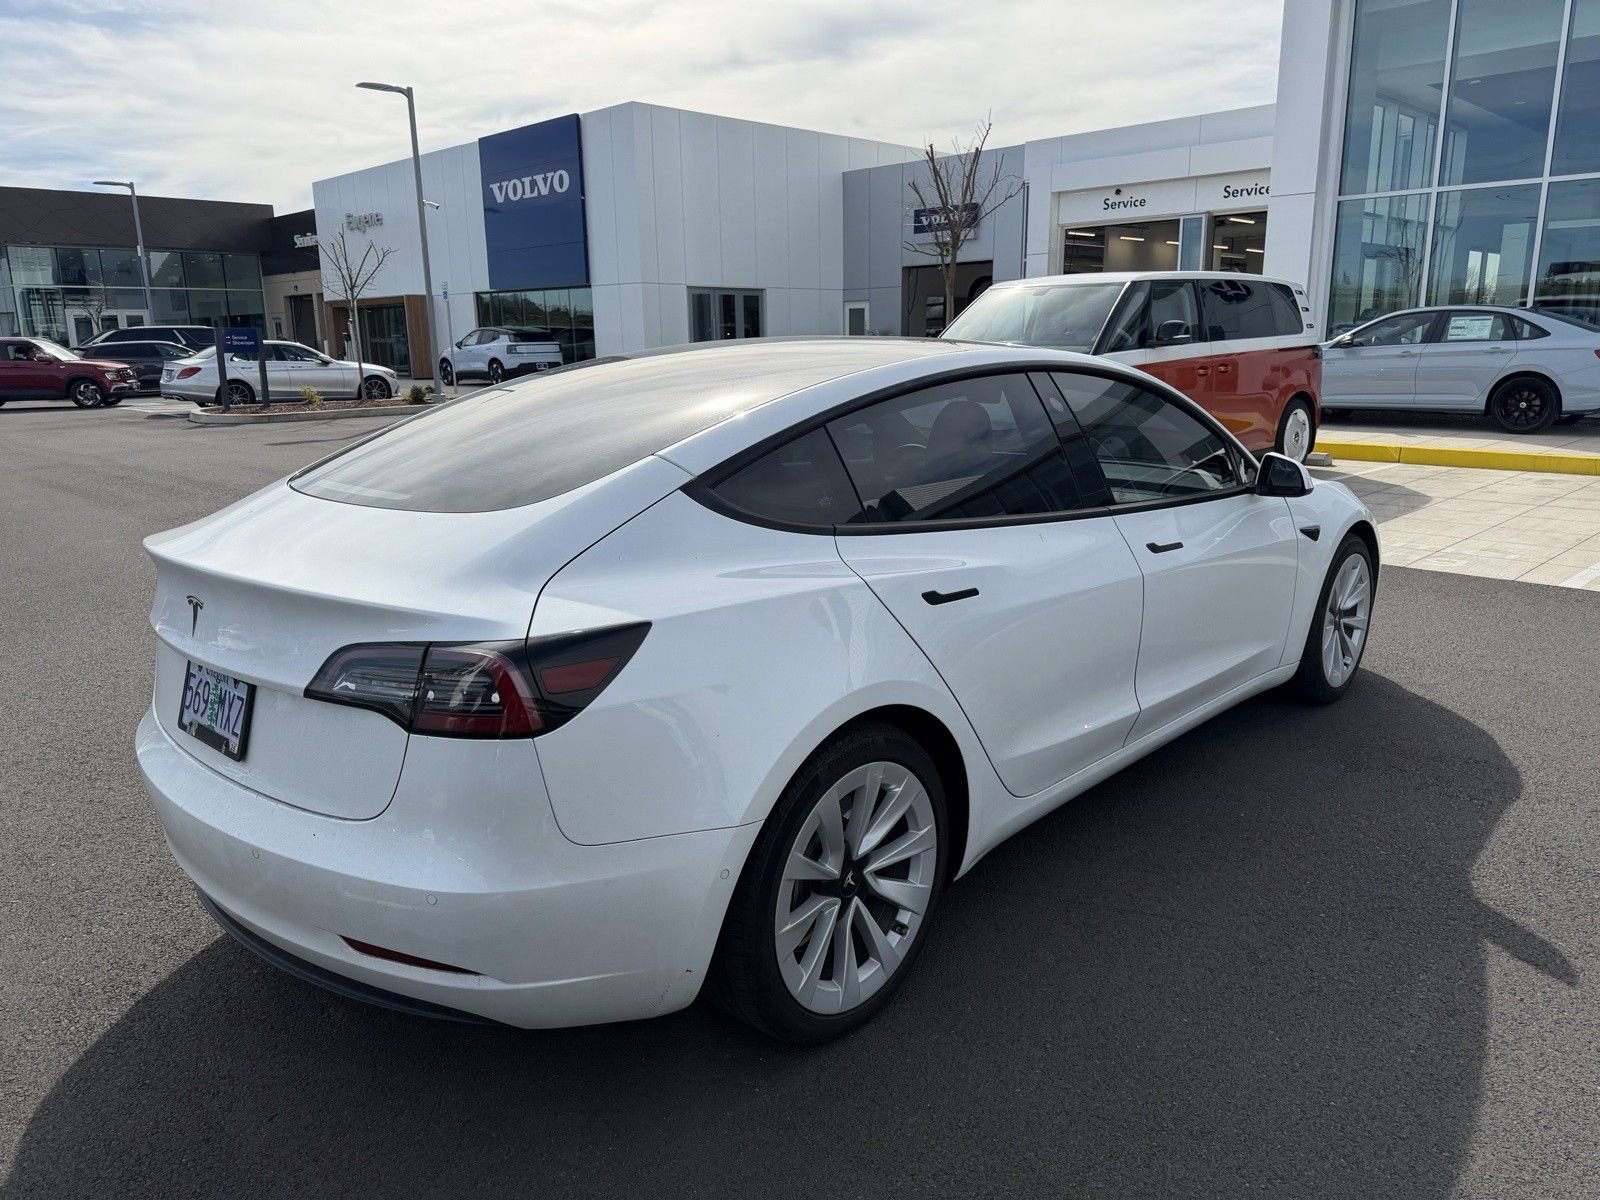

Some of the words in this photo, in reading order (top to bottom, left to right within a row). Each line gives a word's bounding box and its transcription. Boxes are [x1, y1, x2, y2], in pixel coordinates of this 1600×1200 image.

[489, 169, 570, 204] VOLVO
[1103, 196, 1147, 211] Service
[185, 672, 211, 718] 569
[215, 686, 246, 739] MXZ
